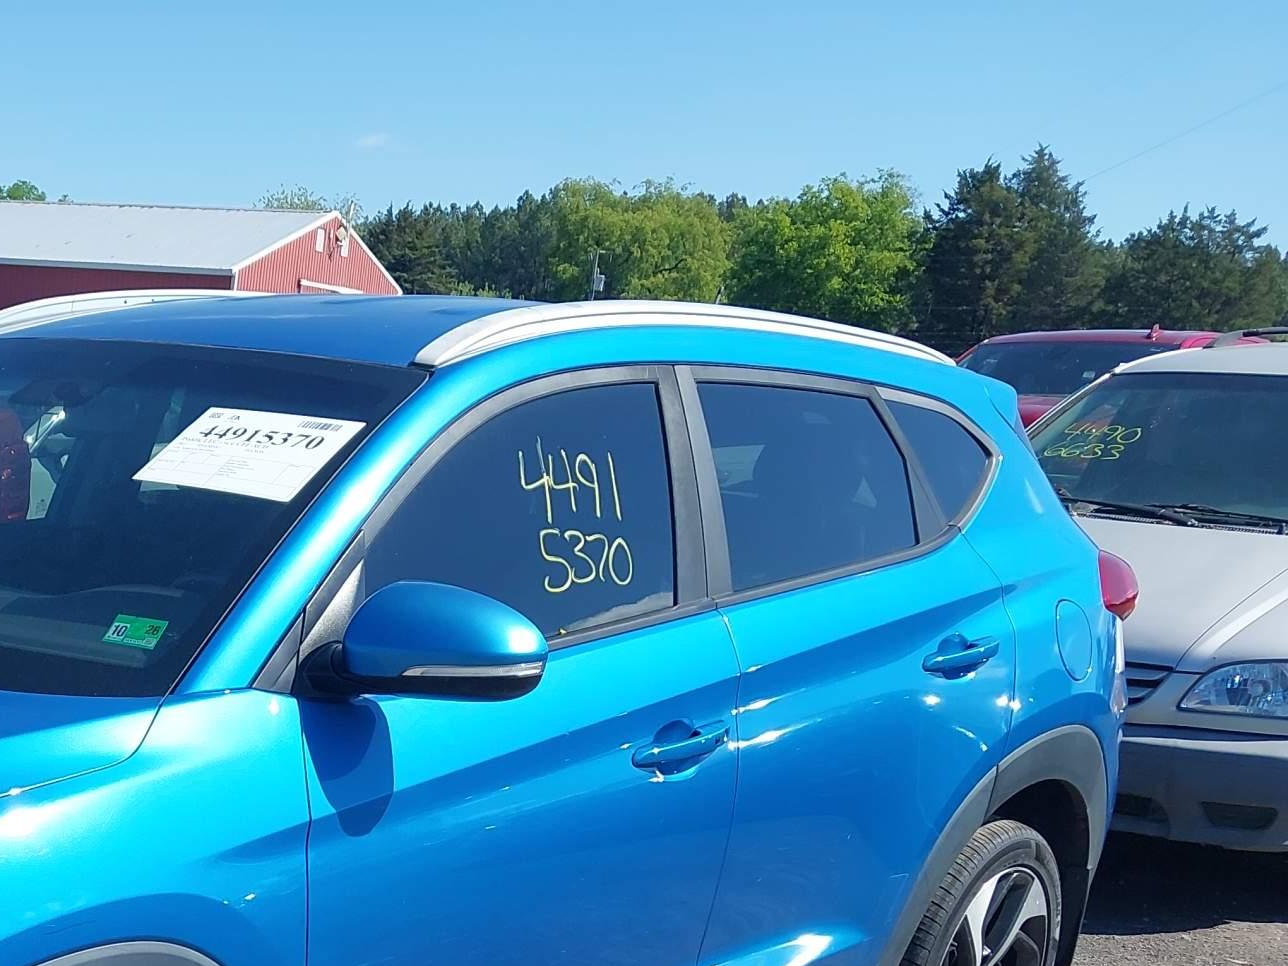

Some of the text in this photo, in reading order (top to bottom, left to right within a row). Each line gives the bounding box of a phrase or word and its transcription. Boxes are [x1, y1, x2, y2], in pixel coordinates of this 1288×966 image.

[199, 425, 325, 450] 44915370
[1043, 441, 1125, 460] 6633
[518, 435, 622, 524] 4491
[539, 528, 634, 593] 5370
[111, 623, 161, 637] 10 26
